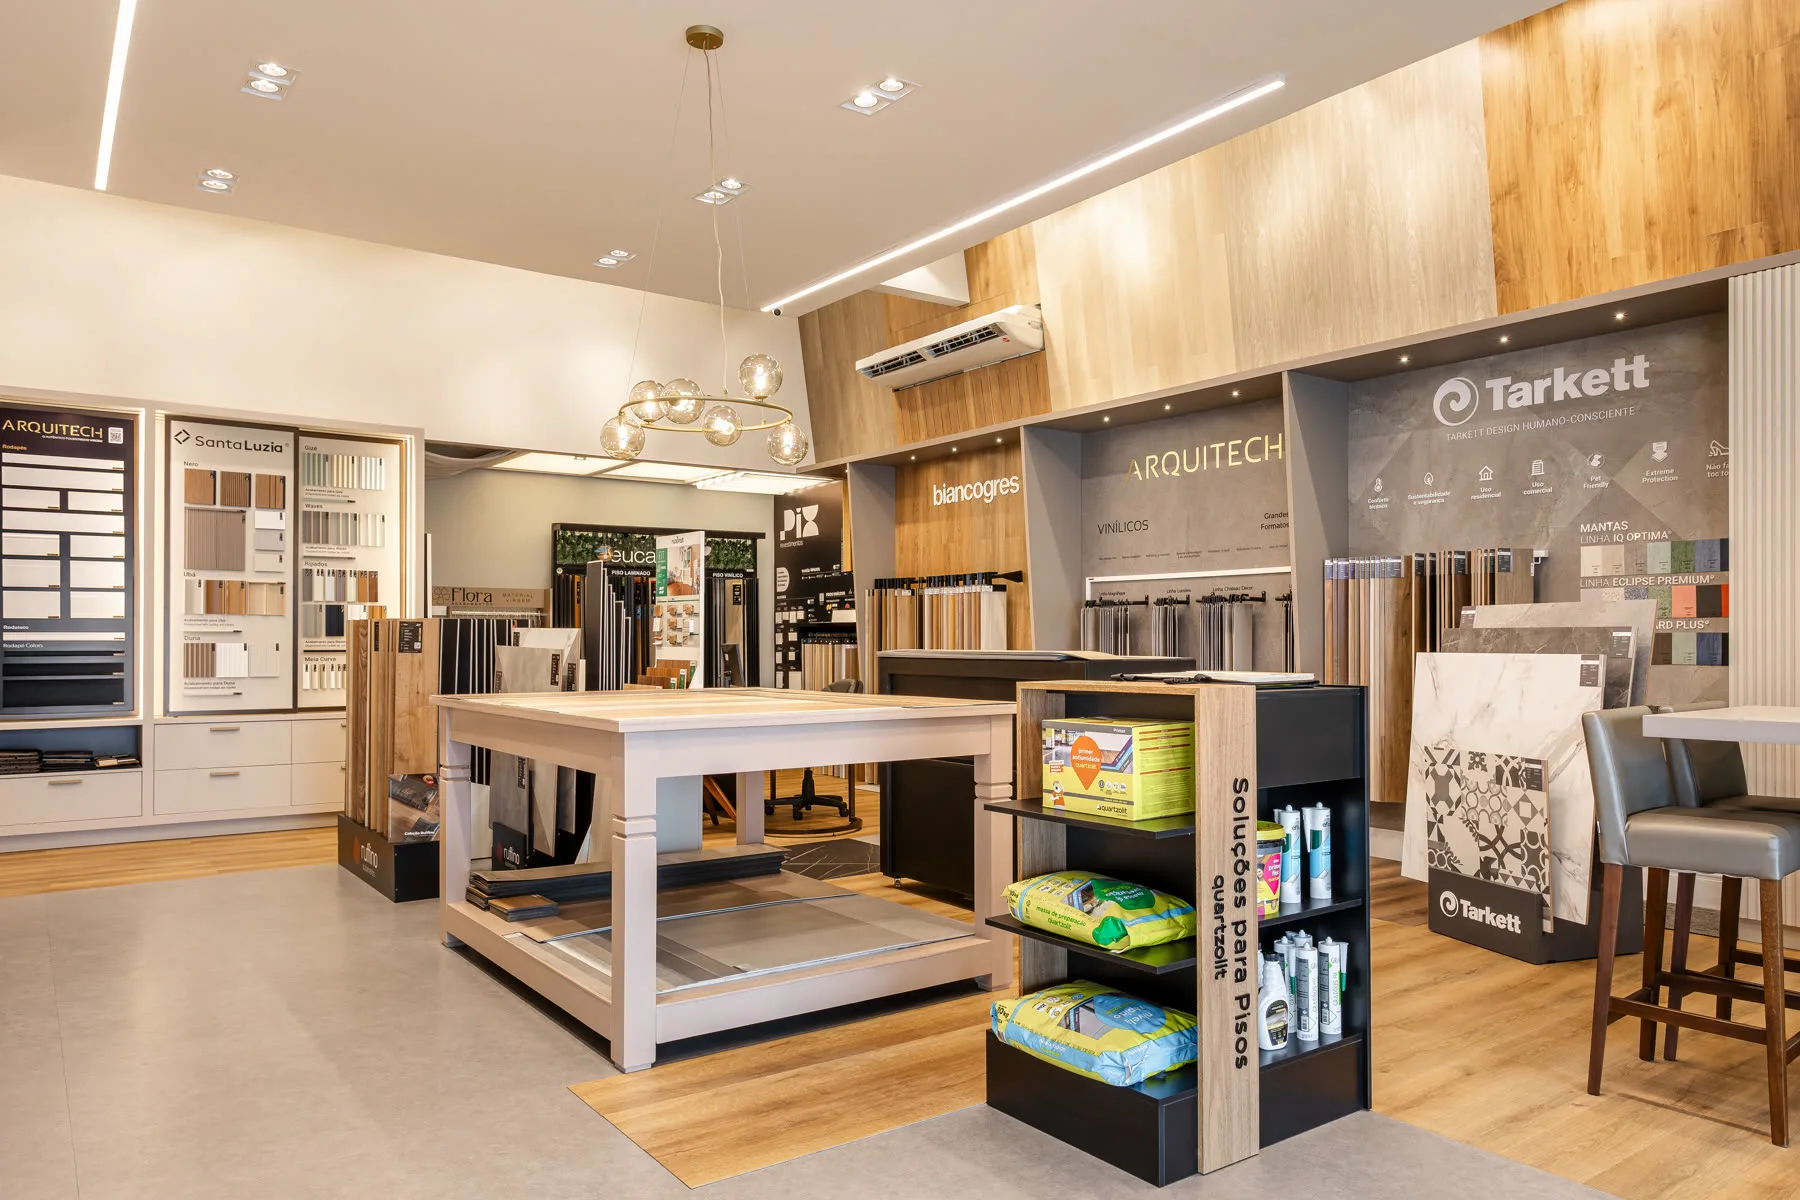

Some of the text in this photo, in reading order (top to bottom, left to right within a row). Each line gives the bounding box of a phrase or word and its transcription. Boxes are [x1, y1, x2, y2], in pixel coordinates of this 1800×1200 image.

[1485, 354, 1650, 411] Tarkett
[2, 419, 104, 439] ARQUITECH
[1446, 406, 1636, 441] TARKETT DESIGN HUMANO-CONSCIENTE
[1126, 433, 1283, 483] ARQUITECH
[1641, 475, 1679, 484] Protection
[1645, 469, 1674, 477] Extreme
[932, 475, 1020, 506] biancogres
[1523, 487, 1553, 495] comercial
[1583, 482, 1609, 490] Friendly
[1408, 491, 1451, 500] Sustentabilidade
[1471, 492, 1501, 500] residencial
[1098, 520, 1149, 534] VINÍLICOS
[1580, 521, 1629, 533] MANTAS
[1580, 535, 1610, 544] LINHA
[1613, 534, 1624, 542] IQ
[1580, 579, 1610, 587] LINHA
[1612, 577, 1655, 587] ECLIPSE
[452, 588, 492, 603] Flora
[1102, 805, 1128, 815] quartzolit
[1232, 777, 1251, 910] Soluções
[1460, 898, 1521, 934] Tarkett
[1211, 874, 1228, 981] quartzolit
[1231, 920, 1248, 984] para
